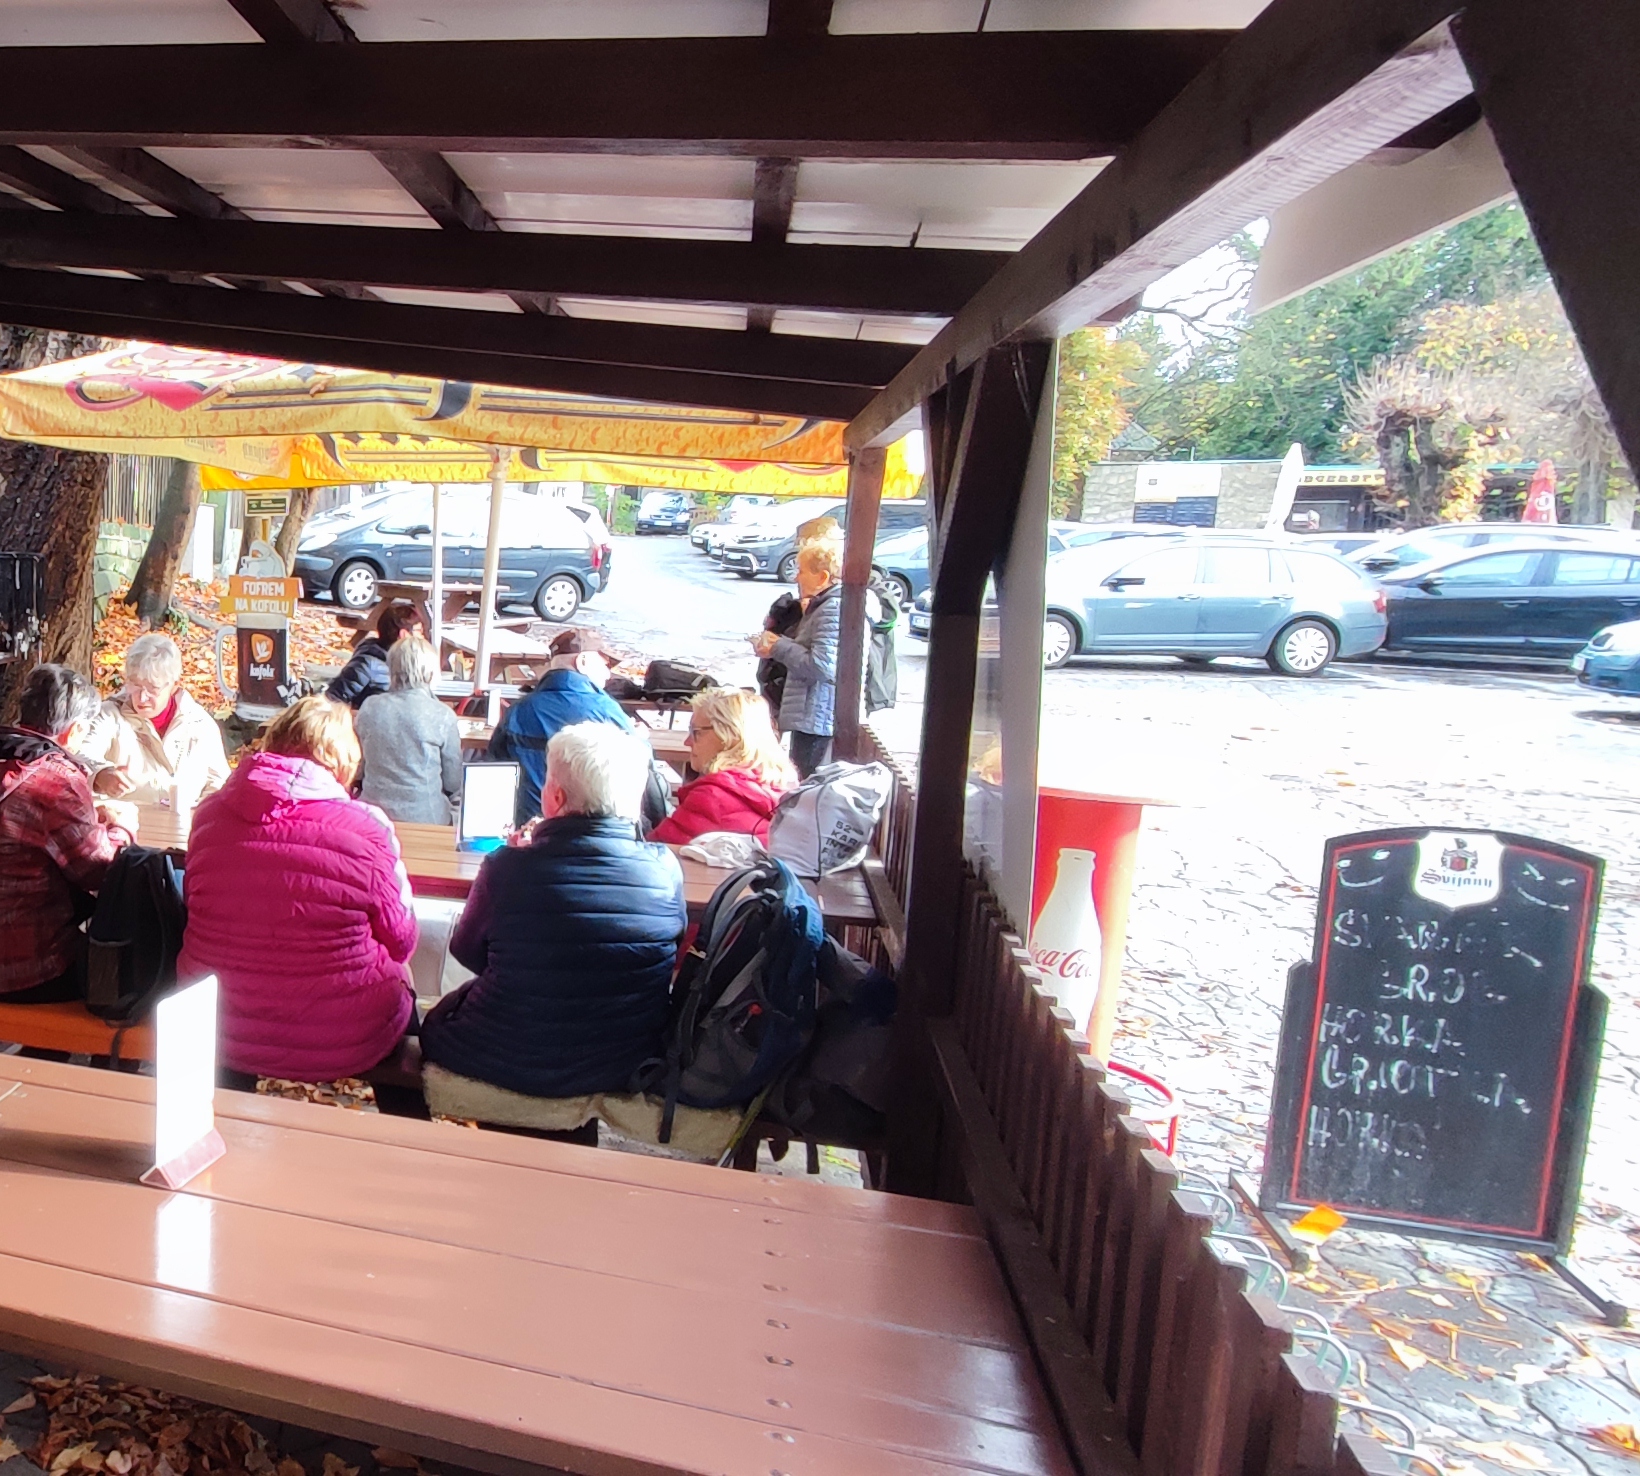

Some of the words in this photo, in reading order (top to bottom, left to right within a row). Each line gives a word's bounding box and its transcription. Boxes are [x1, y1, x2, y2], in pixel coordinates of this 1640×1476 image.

[243, 580, 285, 597] FOFREM
[235, 597, 249, 612] NA
[250, 599, 290, 615] KOFOLU
[1420, 869, 1492, 888] Svijany
